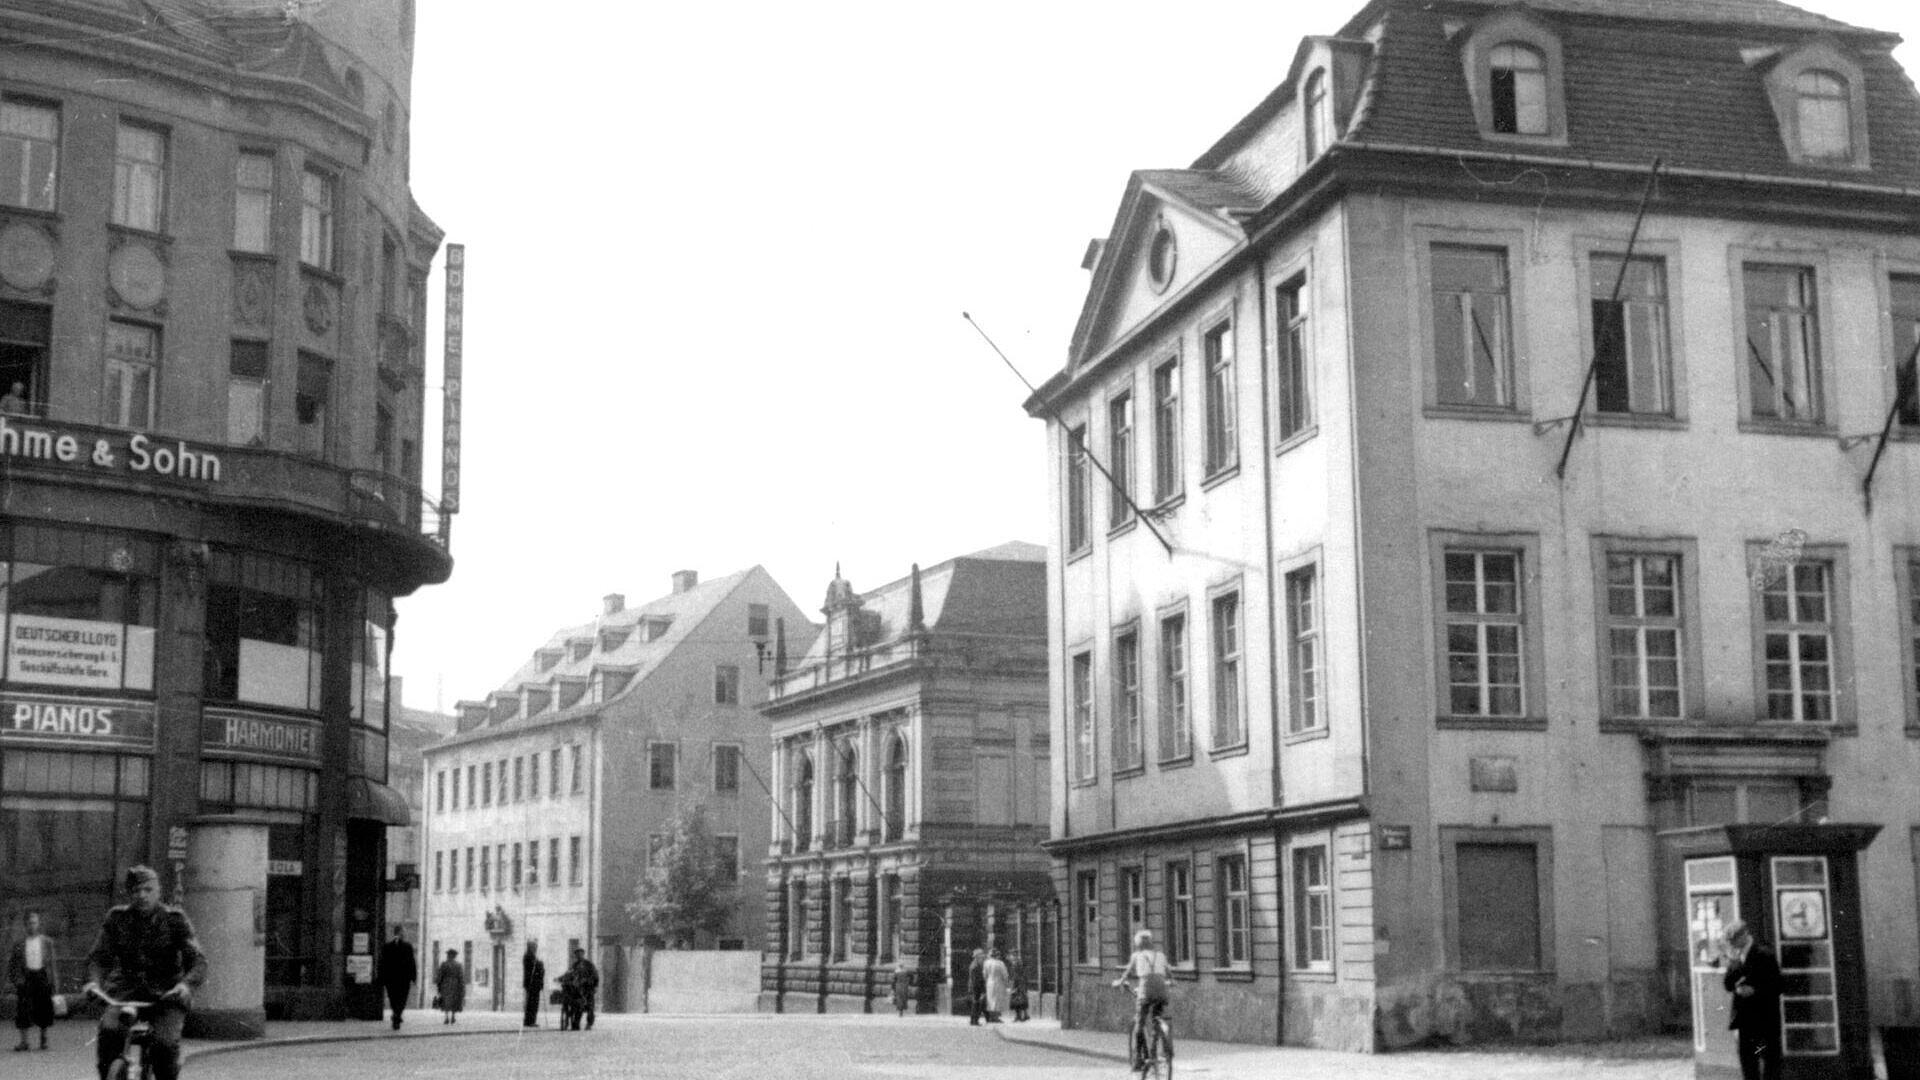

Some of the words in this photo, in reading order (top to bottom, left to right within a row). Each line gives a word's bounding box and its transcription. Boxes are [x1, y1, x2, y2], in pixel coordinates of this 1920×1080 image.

[92, 439, 115, 467] &
[129, 434, 221, 481] Sohn
[13, 703, 113, 735] PIANOS
